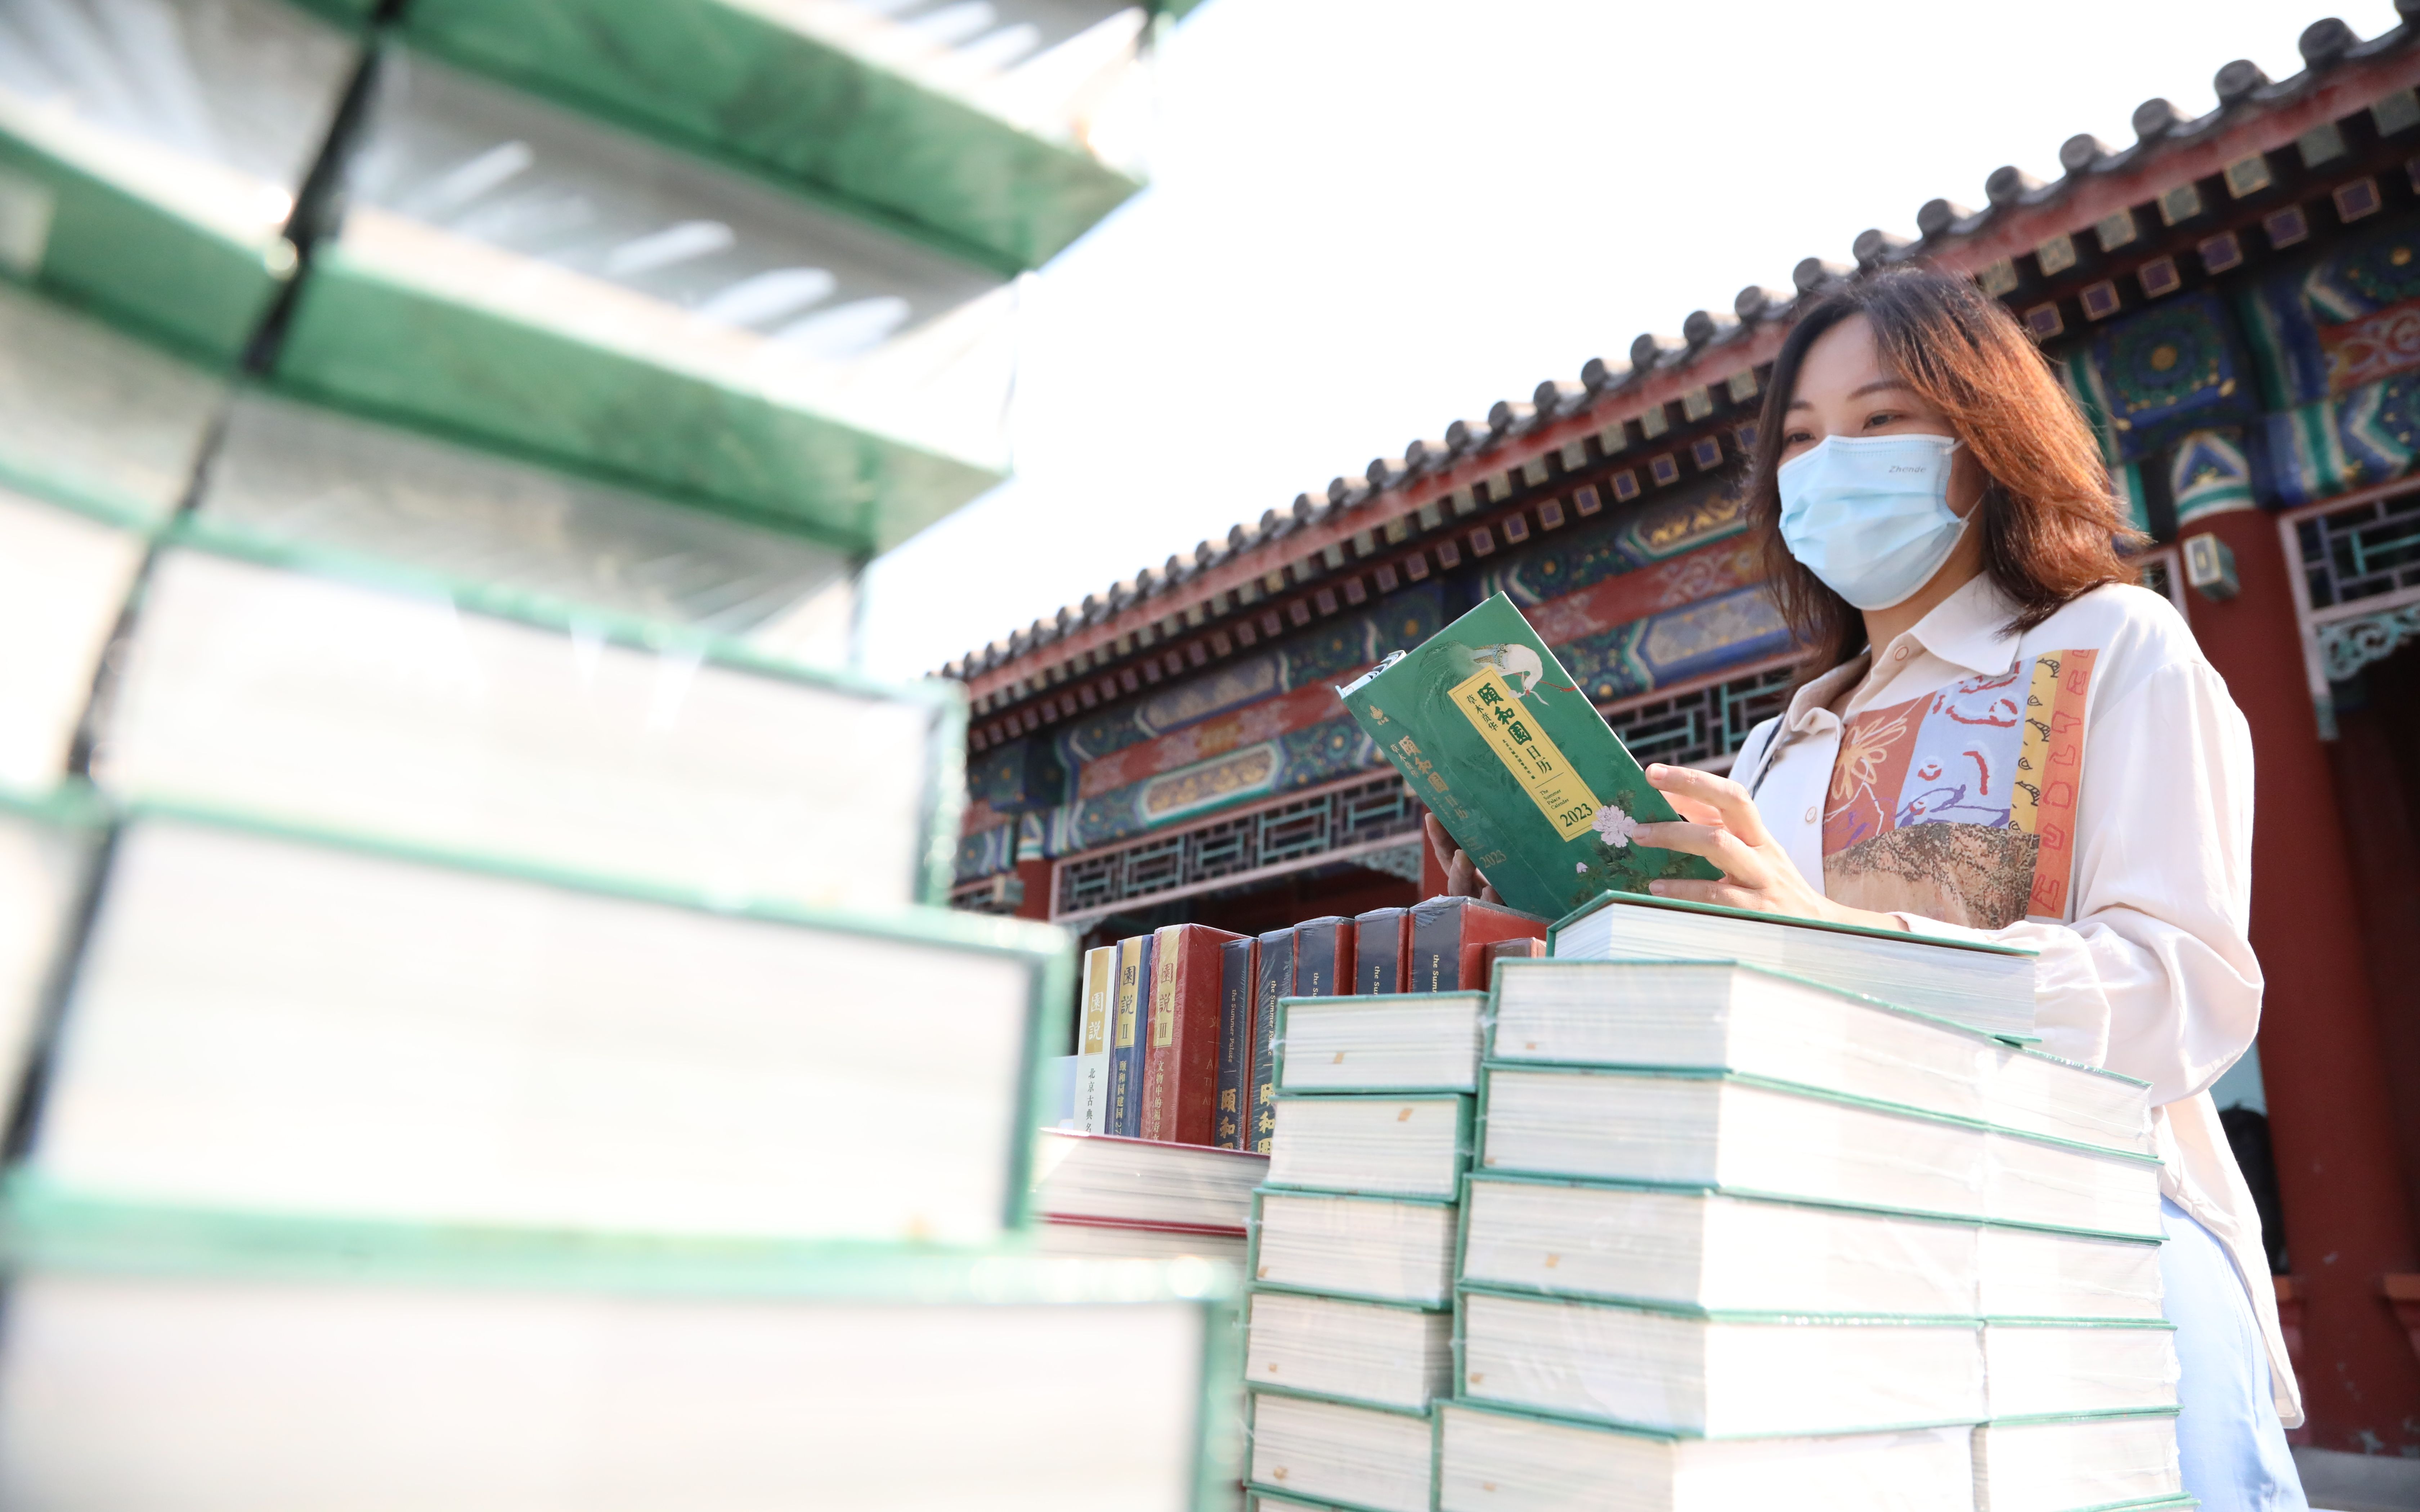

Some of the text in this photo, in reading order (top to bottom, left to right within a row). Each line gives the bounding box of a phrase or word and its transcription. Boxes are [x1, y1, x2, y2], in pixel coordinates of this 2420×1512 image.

[1543, 789, 1561, 800] Summer
[1547, 796, 1561, 805] Palace
[1560, 803, 1592, 827] 2023
[1479, 850, 1507, 868] 2023
